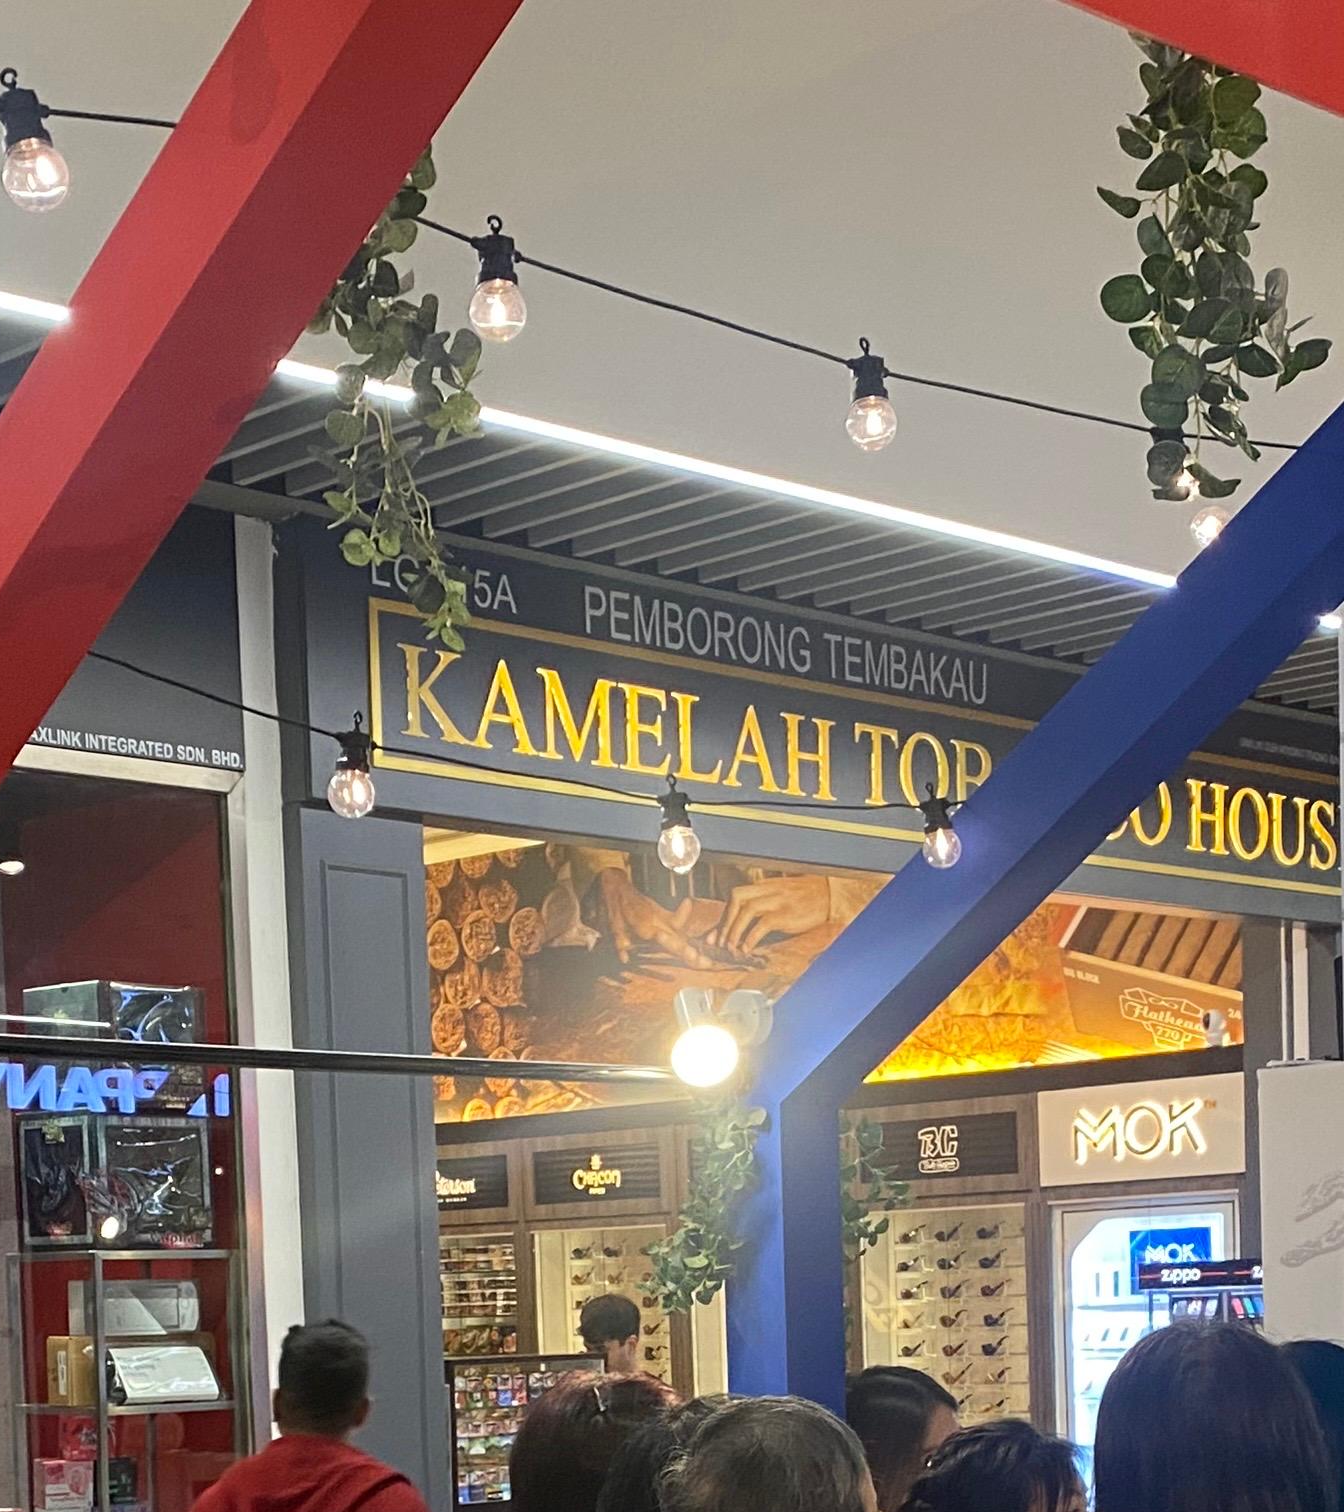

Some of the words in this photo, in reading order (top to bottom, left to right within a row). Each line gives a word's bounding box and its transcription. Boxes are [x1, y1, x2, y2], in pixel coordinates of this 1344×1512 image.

[584, 585, 813, 674] PEMBORONG
[822, 632, 988, 705] TEMBAKAU
[30, 727, 82, 748] AXLINK
[85, 732, 174, 759] INTEGRATED
[176, 745, 209, 764] SDN.
[212, 750, 244, 769] BHD.
[397, 642, 837, 802] KAMELAH
[1186, 778, 1342, 871] HOUS
[1072, 1098, 1208, 1166] MOK
